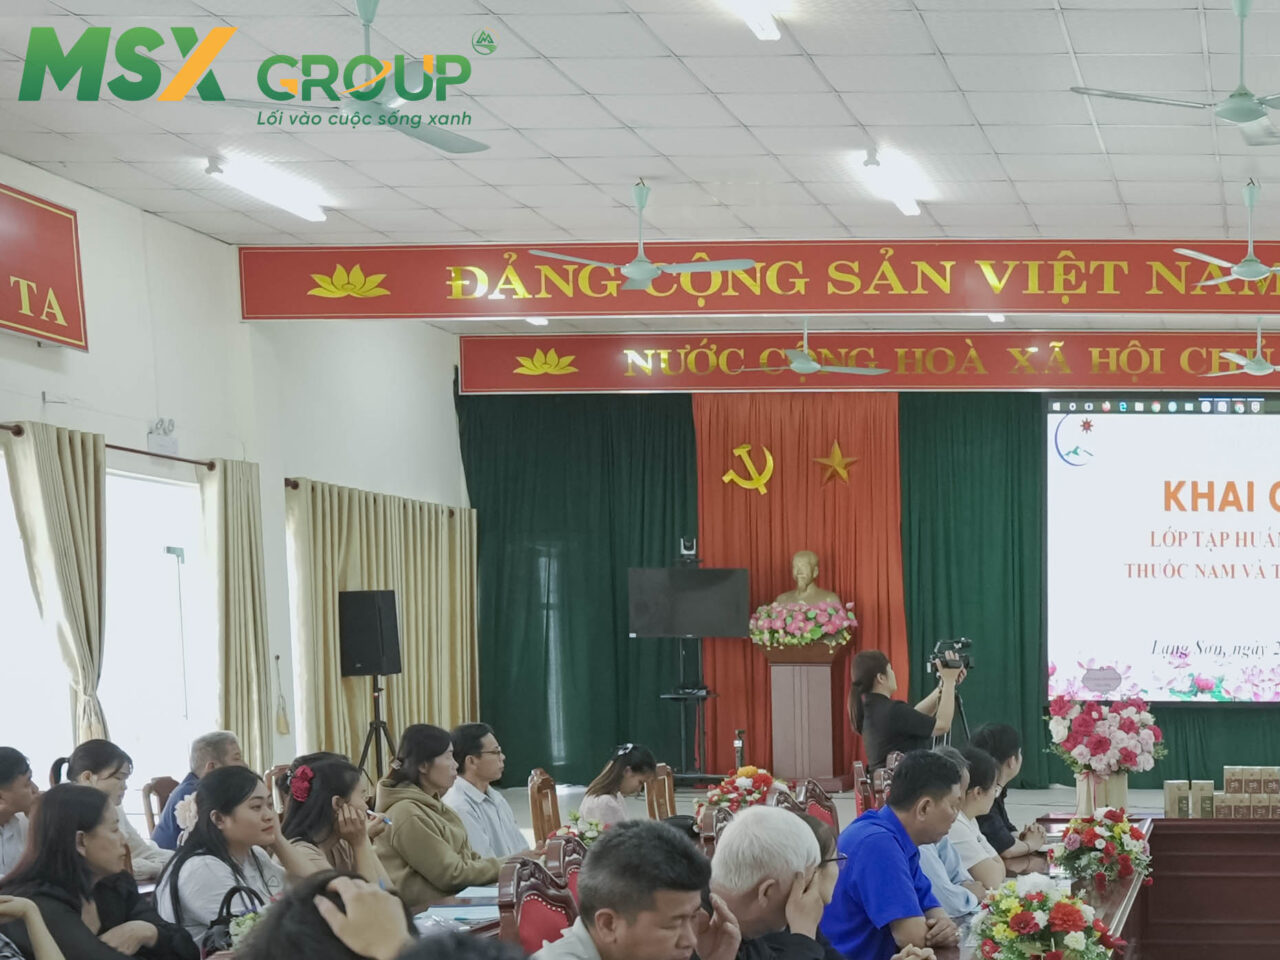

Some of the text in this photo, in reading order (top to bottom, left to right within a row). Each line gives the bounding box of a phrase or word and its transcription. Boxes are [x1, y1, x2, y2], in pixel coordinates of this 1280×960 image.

[445, 251, 621, 300] ĐẢNG
[643, 252, 810, 308] CỘNG
[826, 247, 956, 296] SẢN
[974, 250, 1128, 305] VIỆT
[9, 275, 68, 327] TA
[623, 338, 745, 376] NƯỚC
[894, 338, 988, 375] HOÀ
[1006, 341, 1072, 375] XÃ
[1088, 340, 1165, 383] HỘI
[1164, 480, 1254, 512] KHAI
[1195, 563, 1235, 579] NAM
